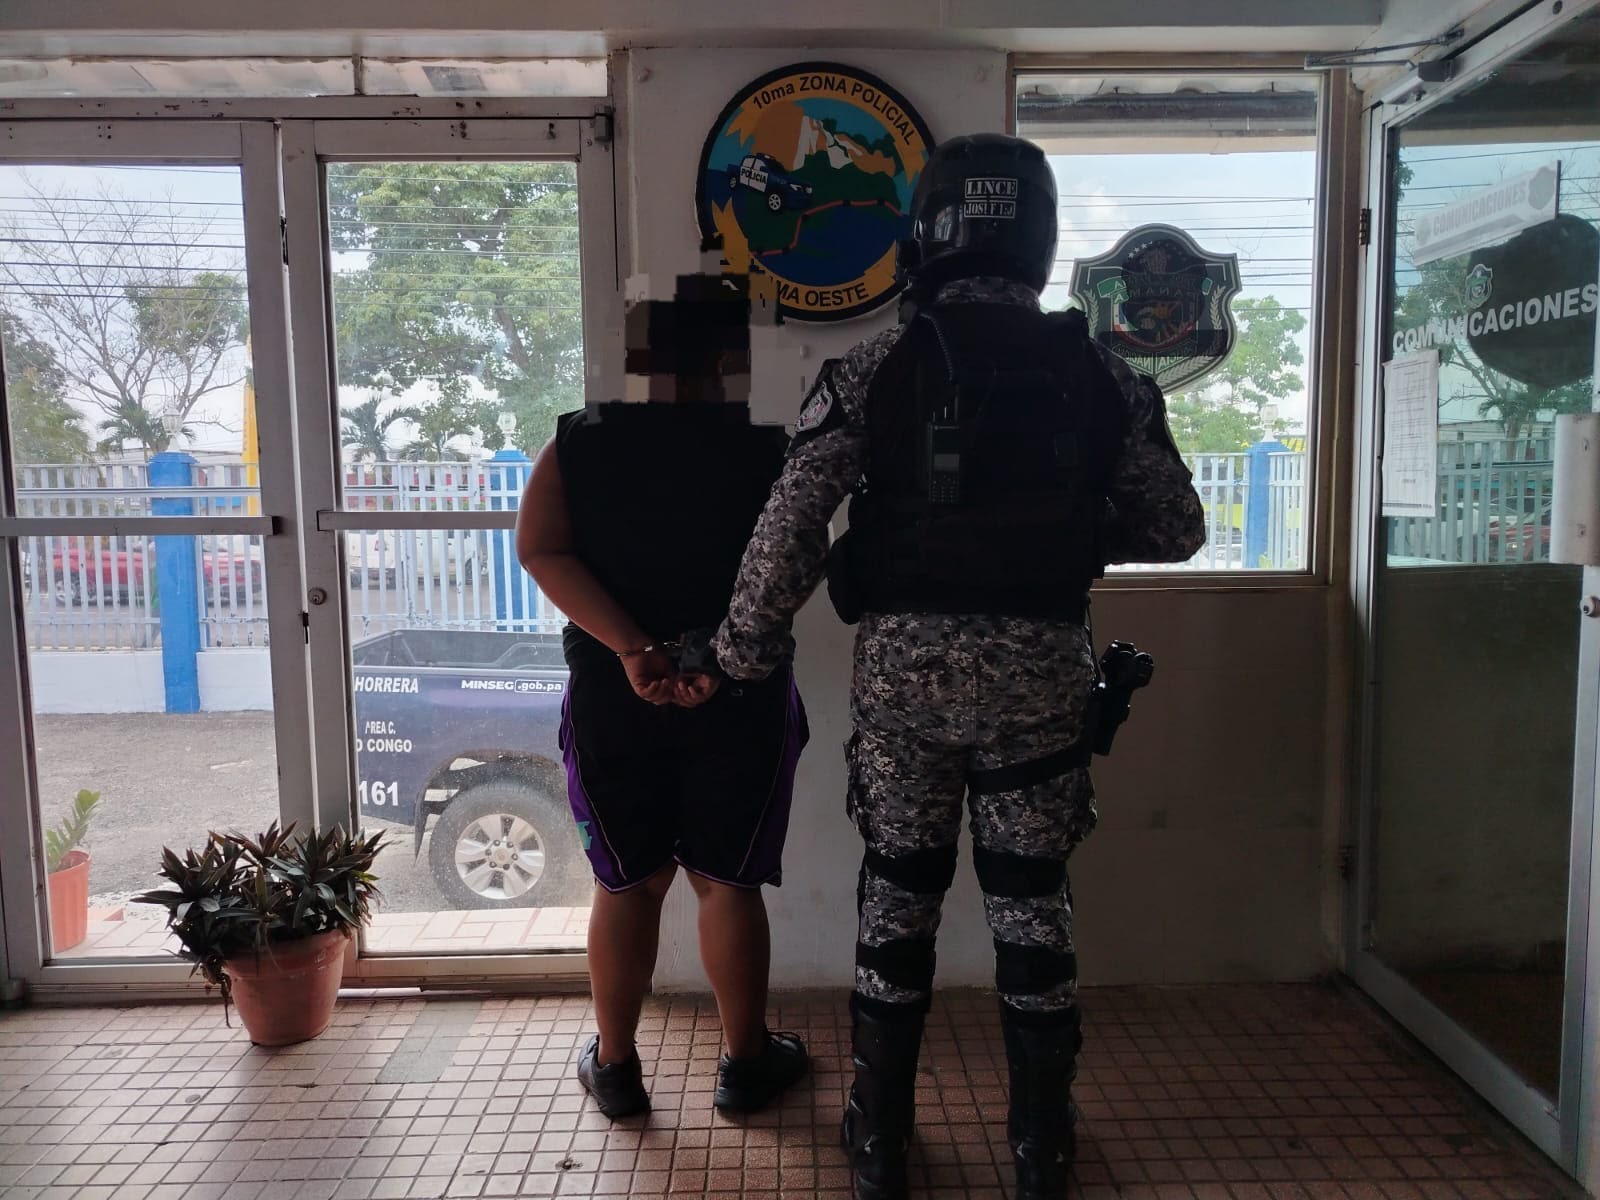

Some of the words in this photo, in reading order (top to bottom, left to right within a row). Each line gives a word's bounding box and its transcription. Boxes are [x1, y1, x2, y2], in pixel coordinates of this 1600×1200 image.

[753, 82, 795, 110] 10ma
[799, 75, 847, 94] ZONA
[850, 83, 914, 145] POLICIAL
[740, 167, 768, 185] POLICIA
[967, 181, 1016, 195] LINCE
[805, 282, 869, 306] OESTE
[1393, 284, 1598, 352] COMUNICACIONES
[461, 680, 514, 690] MINSEG
[367, 738, 412, 752] CONGO
[359, 781, 399, 806] 161
